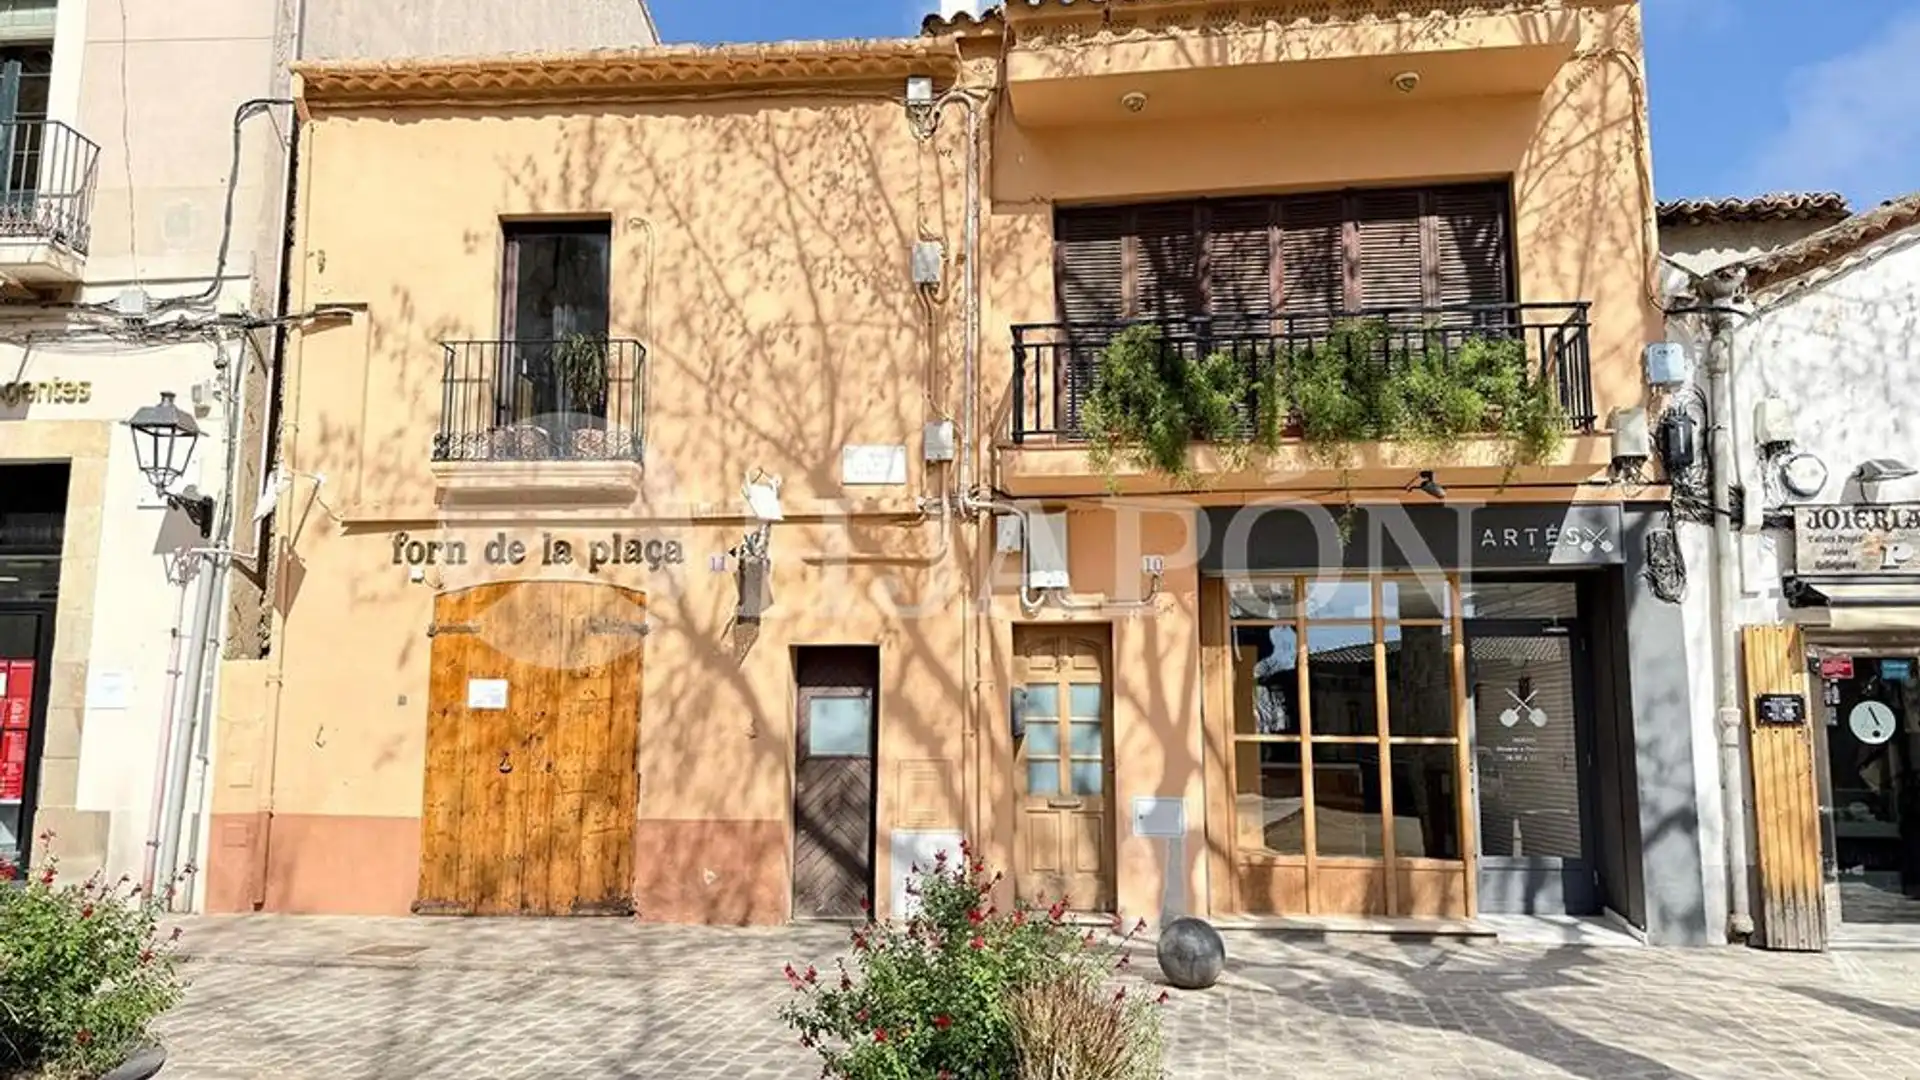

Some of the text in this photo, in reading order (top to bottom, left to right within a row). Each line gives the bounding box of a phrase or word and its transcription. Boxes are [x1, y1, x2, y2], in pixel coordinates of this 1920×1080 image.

[1481, 524, 1582, 547] ARTÉS
[392, 532, 684, 573] forn de la plaça
[1144, 558, 1164, 573] 10
